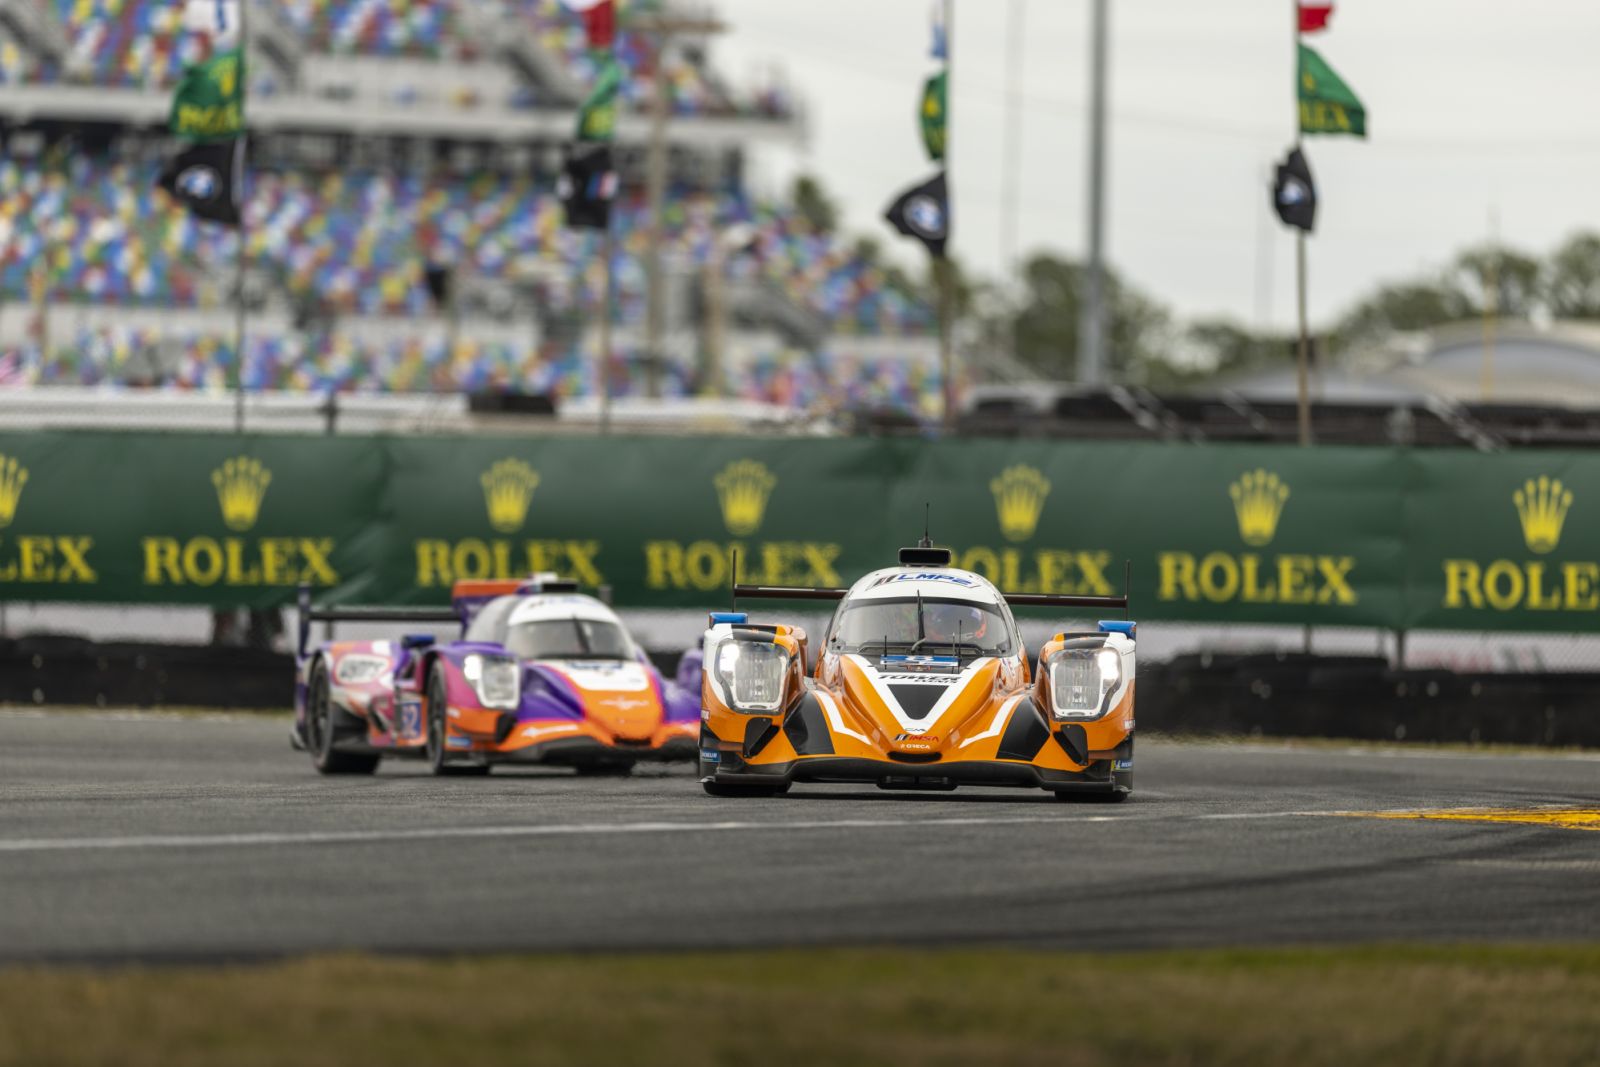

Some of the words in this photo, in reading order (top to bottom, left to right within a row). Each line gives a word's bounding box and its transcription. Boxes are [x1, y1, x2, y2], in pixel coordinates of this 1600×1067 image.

[144, 536, 337, 586] ROLEX
[416, 540, 603, 587] ROLEX
[646, 540, 842, 590] ROLEX
[897, 574, 972, 585] LMP2
[949, 546, 1112, 595] OLEX
[1158, 552, 1356, 605] ROLEX
[1442, 559, 1600, 611] ROLE
